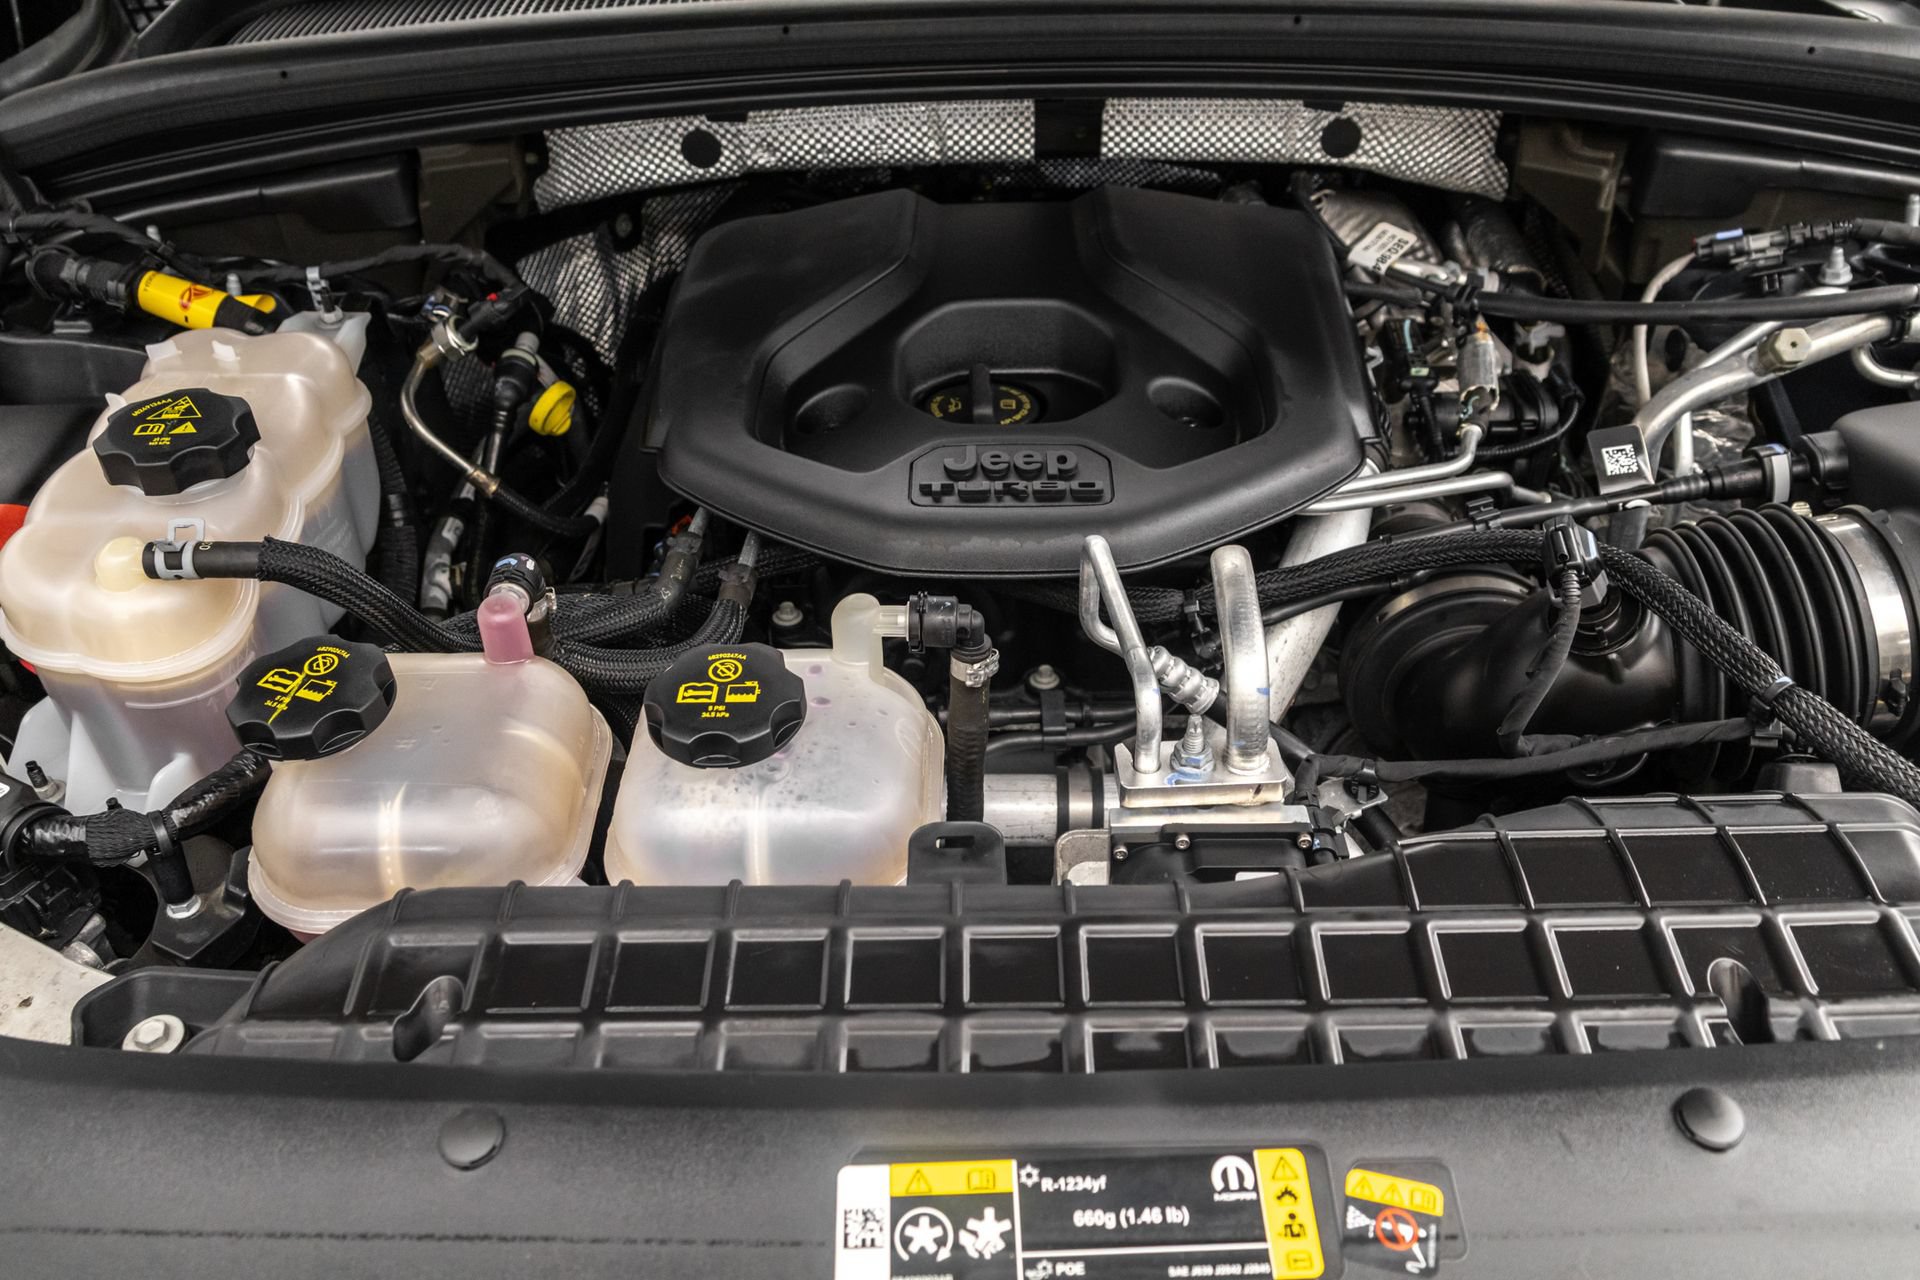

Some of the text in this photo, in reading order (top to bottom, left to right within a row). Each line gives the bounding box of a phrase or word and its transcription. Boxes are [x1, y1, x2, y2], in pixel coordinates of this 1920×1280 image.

[943, 445, 1078, 481] Jeep
[918, 480, 1105, 503] TURBO
[1041, 1174, 1107, 1193] R-1234yf
[1073, 1204, 1190, 1230] 660g (1.46 lb)
[1055, 1261, 1086, 1276] POE
